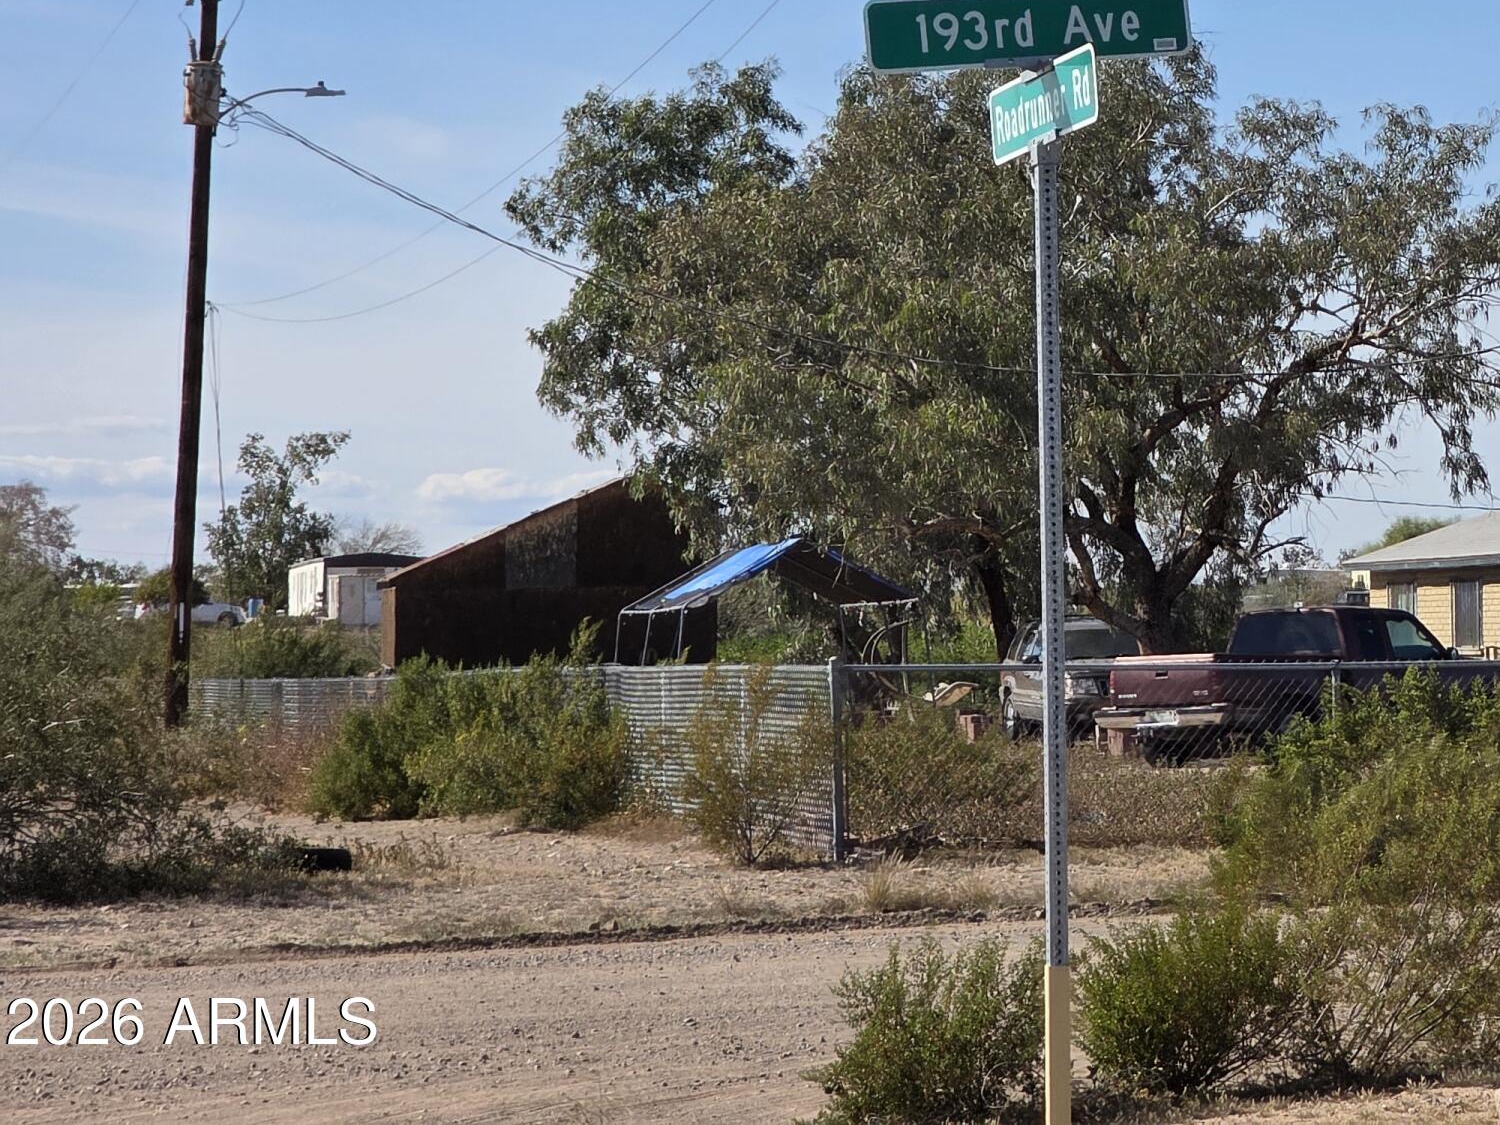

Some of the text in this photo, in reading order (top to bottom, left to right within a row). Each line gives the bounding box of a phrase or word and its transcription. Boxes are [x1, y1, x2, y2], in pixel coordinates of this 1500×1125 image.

[915, 4, 1140, 53] 193rd Ave
[995, 65, 1091, 146] Roadrunner Rd
